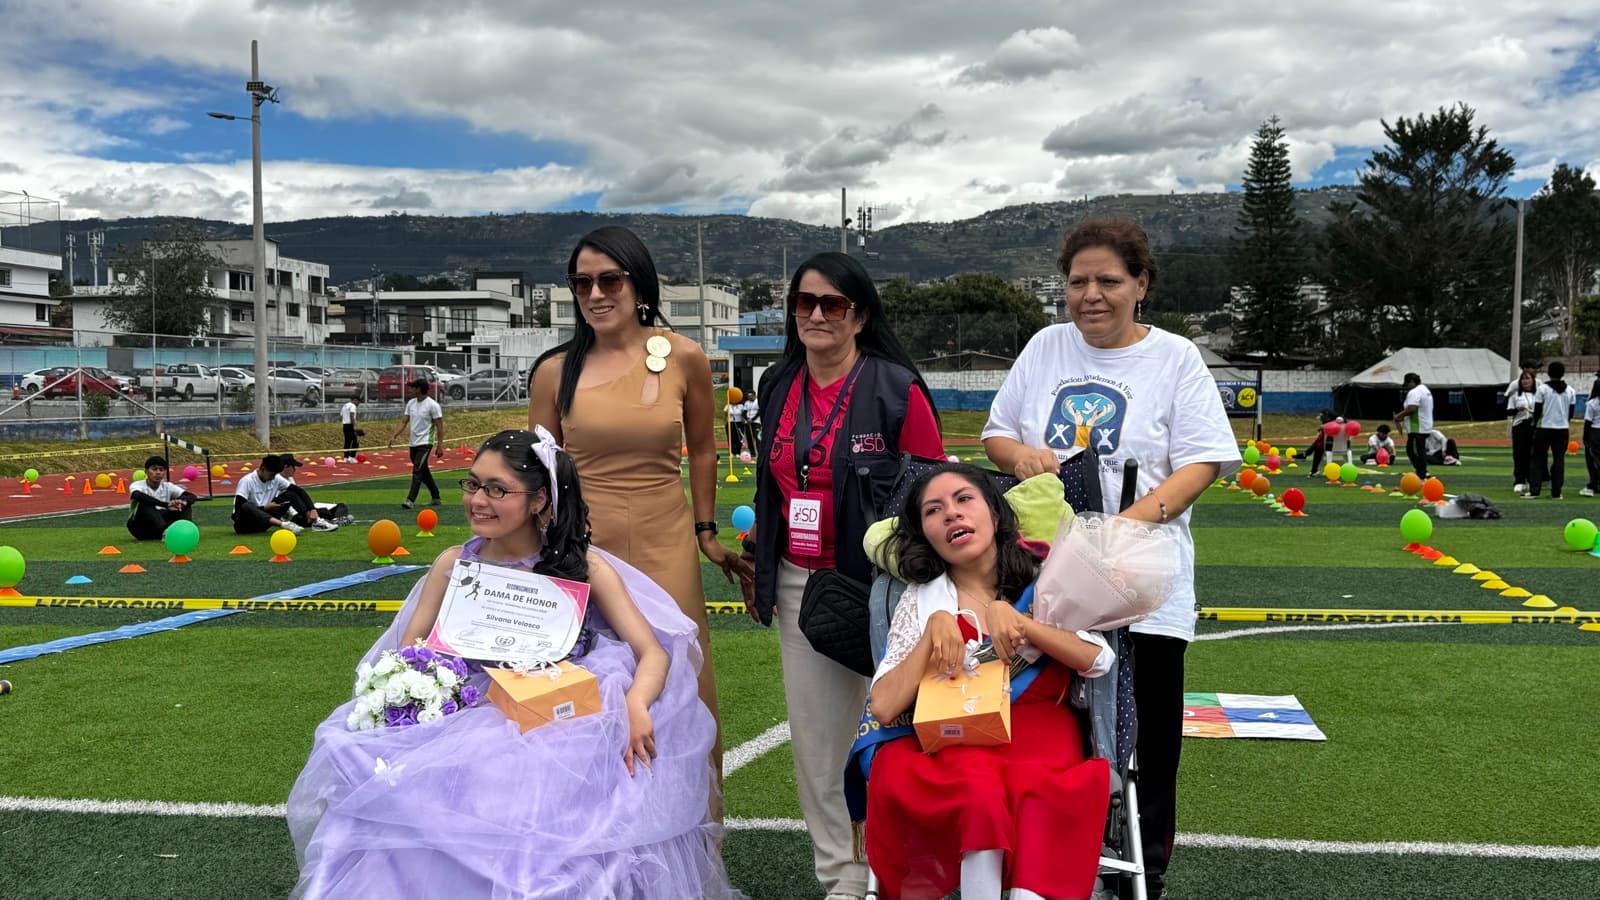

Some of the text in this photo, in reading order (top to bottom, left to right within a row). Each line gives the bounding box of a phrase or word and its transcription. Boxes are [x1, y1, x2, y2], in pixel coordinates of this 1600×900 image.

[484, 589, 511, 600] DAMA
[513, 594, 525, 603] DE
[526, 597, 558, 609] HONOR
[486, 614, 512, 624] Silvana
[513, 619, 541, 630] Velasco
